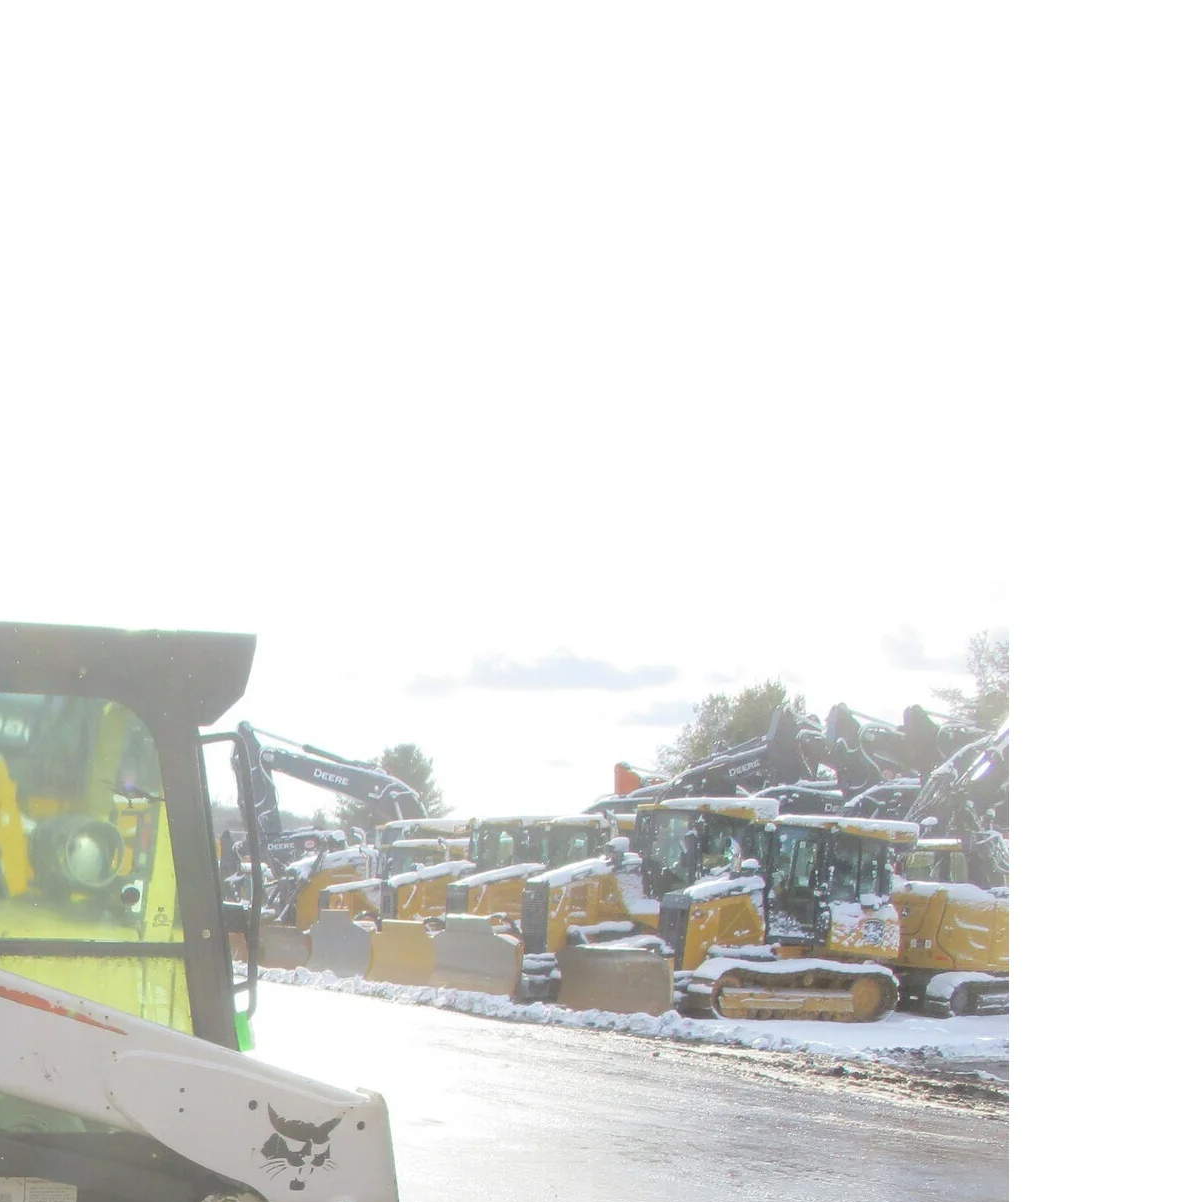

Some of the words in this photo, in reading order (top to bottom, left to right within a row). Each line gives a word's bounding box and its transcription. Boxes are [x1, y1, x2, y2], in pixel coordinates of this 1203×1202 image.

[313, 768, 349, 786] DEERE
[728, 760, 761, 777] DEERE
[267, 842, 295, 851] DEERE
